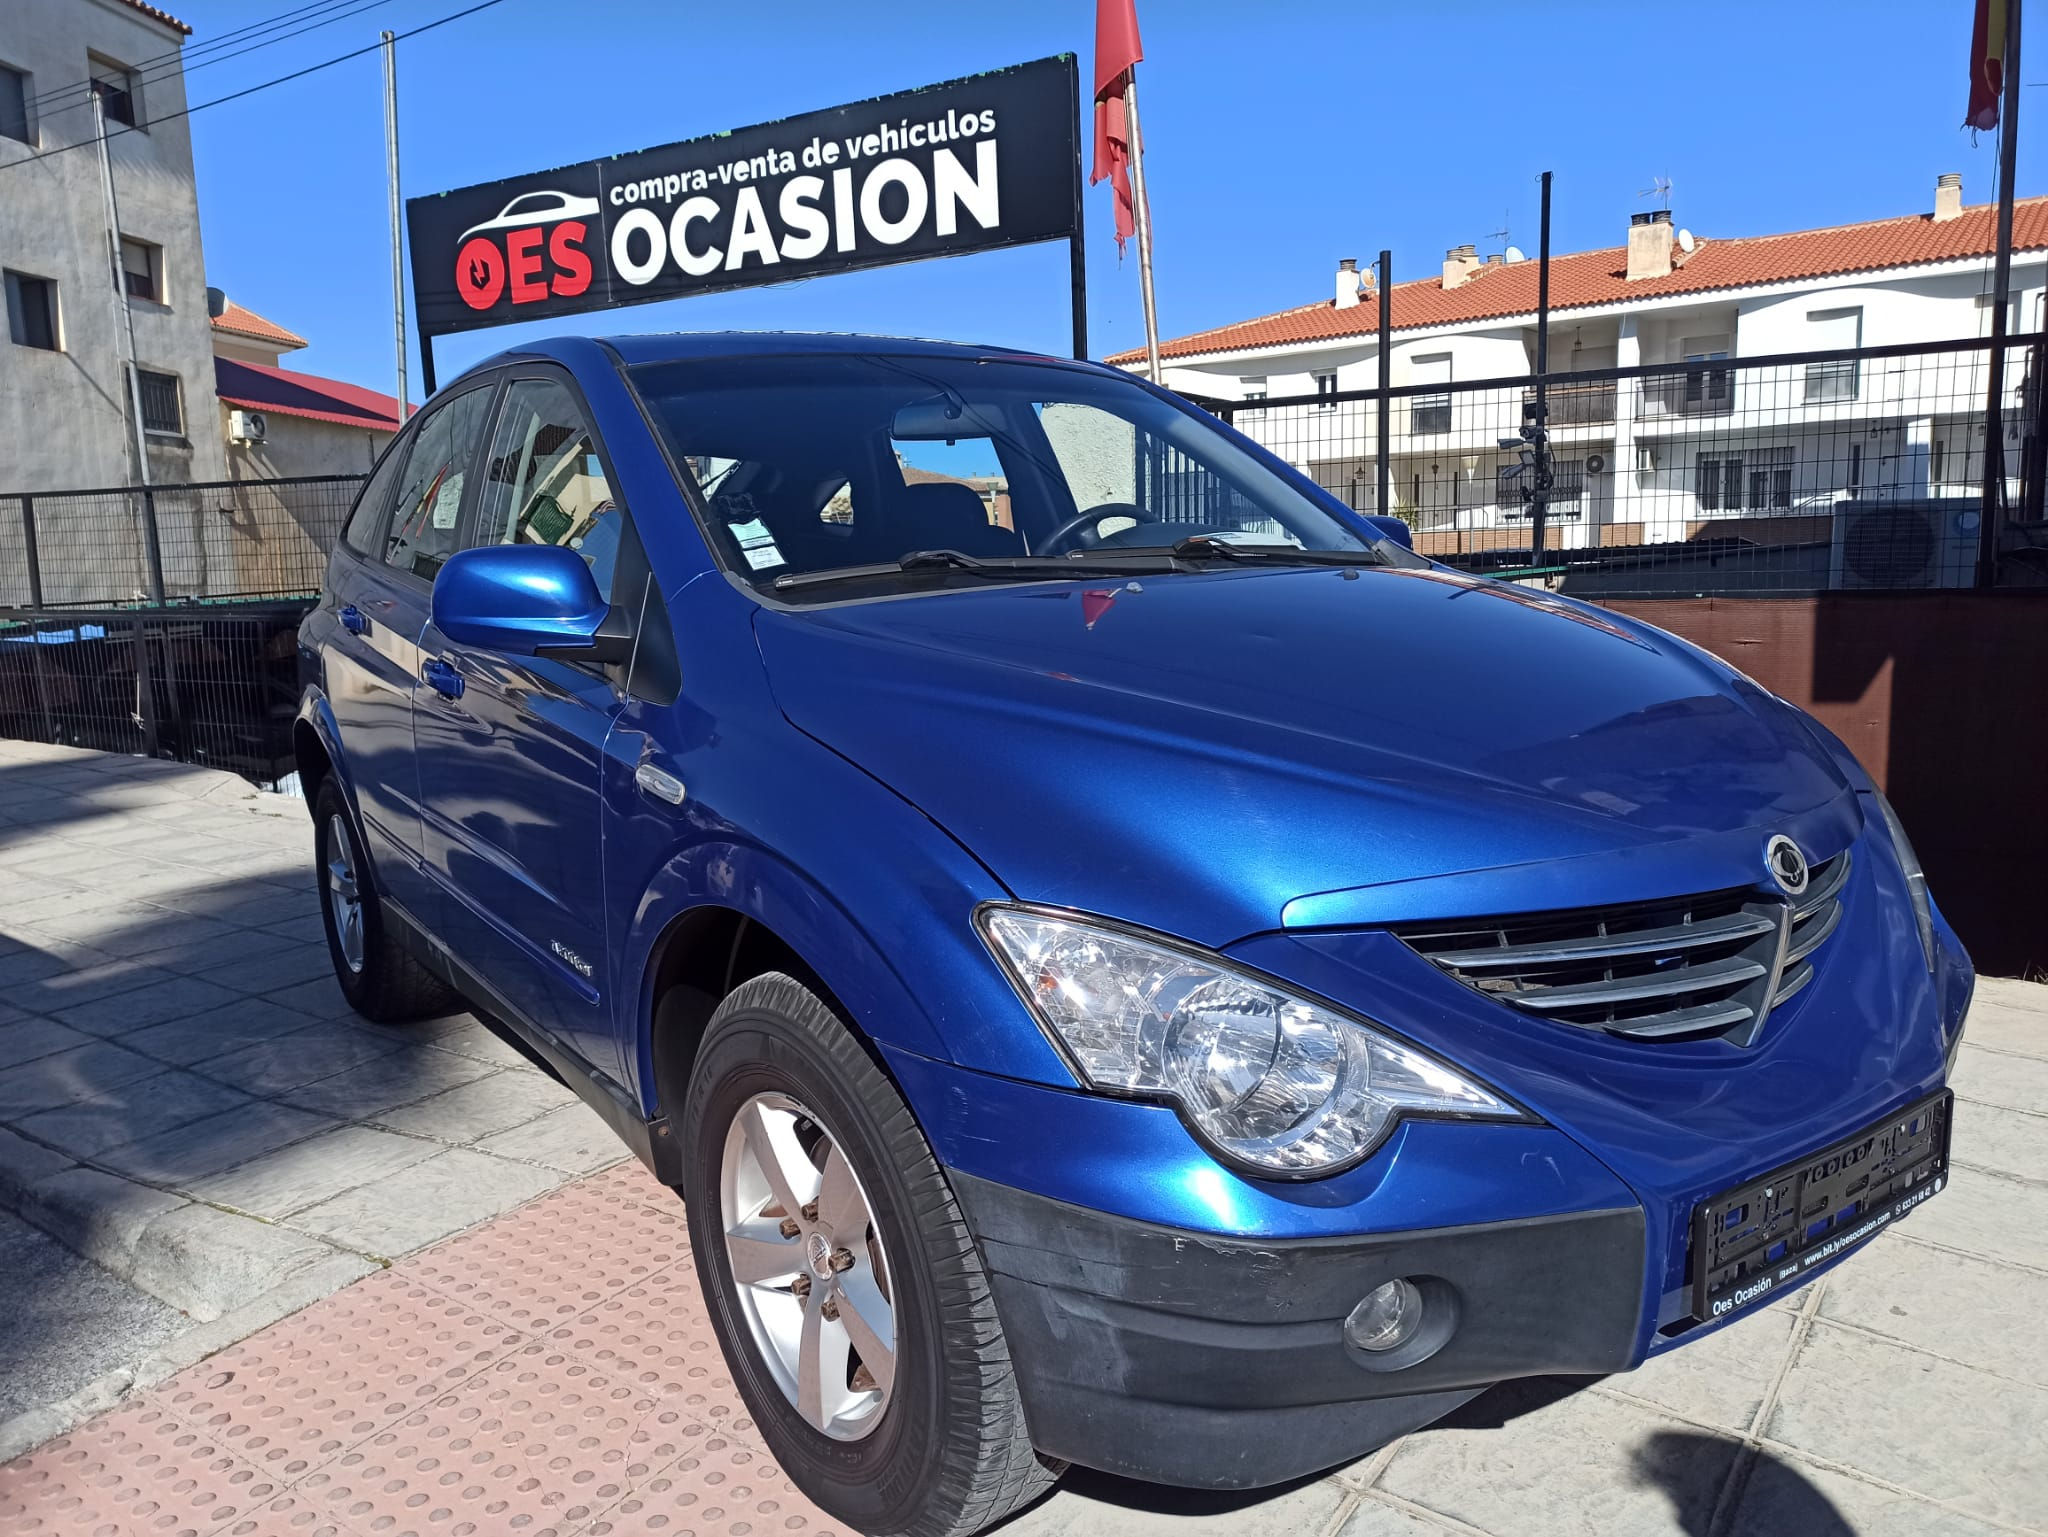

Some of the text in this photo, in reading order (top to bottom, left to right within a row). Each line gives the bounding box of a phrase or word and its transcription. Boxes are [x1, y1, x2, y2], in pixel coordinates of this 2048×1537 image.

[610, 109, 997, 205] compra-venta de vehículos
[456, 139, 1000, 310] OES OCASION
[1713, 1298, 1732, 1315] Oes
[1735, 1277, 1772, 1305] Ocasión
